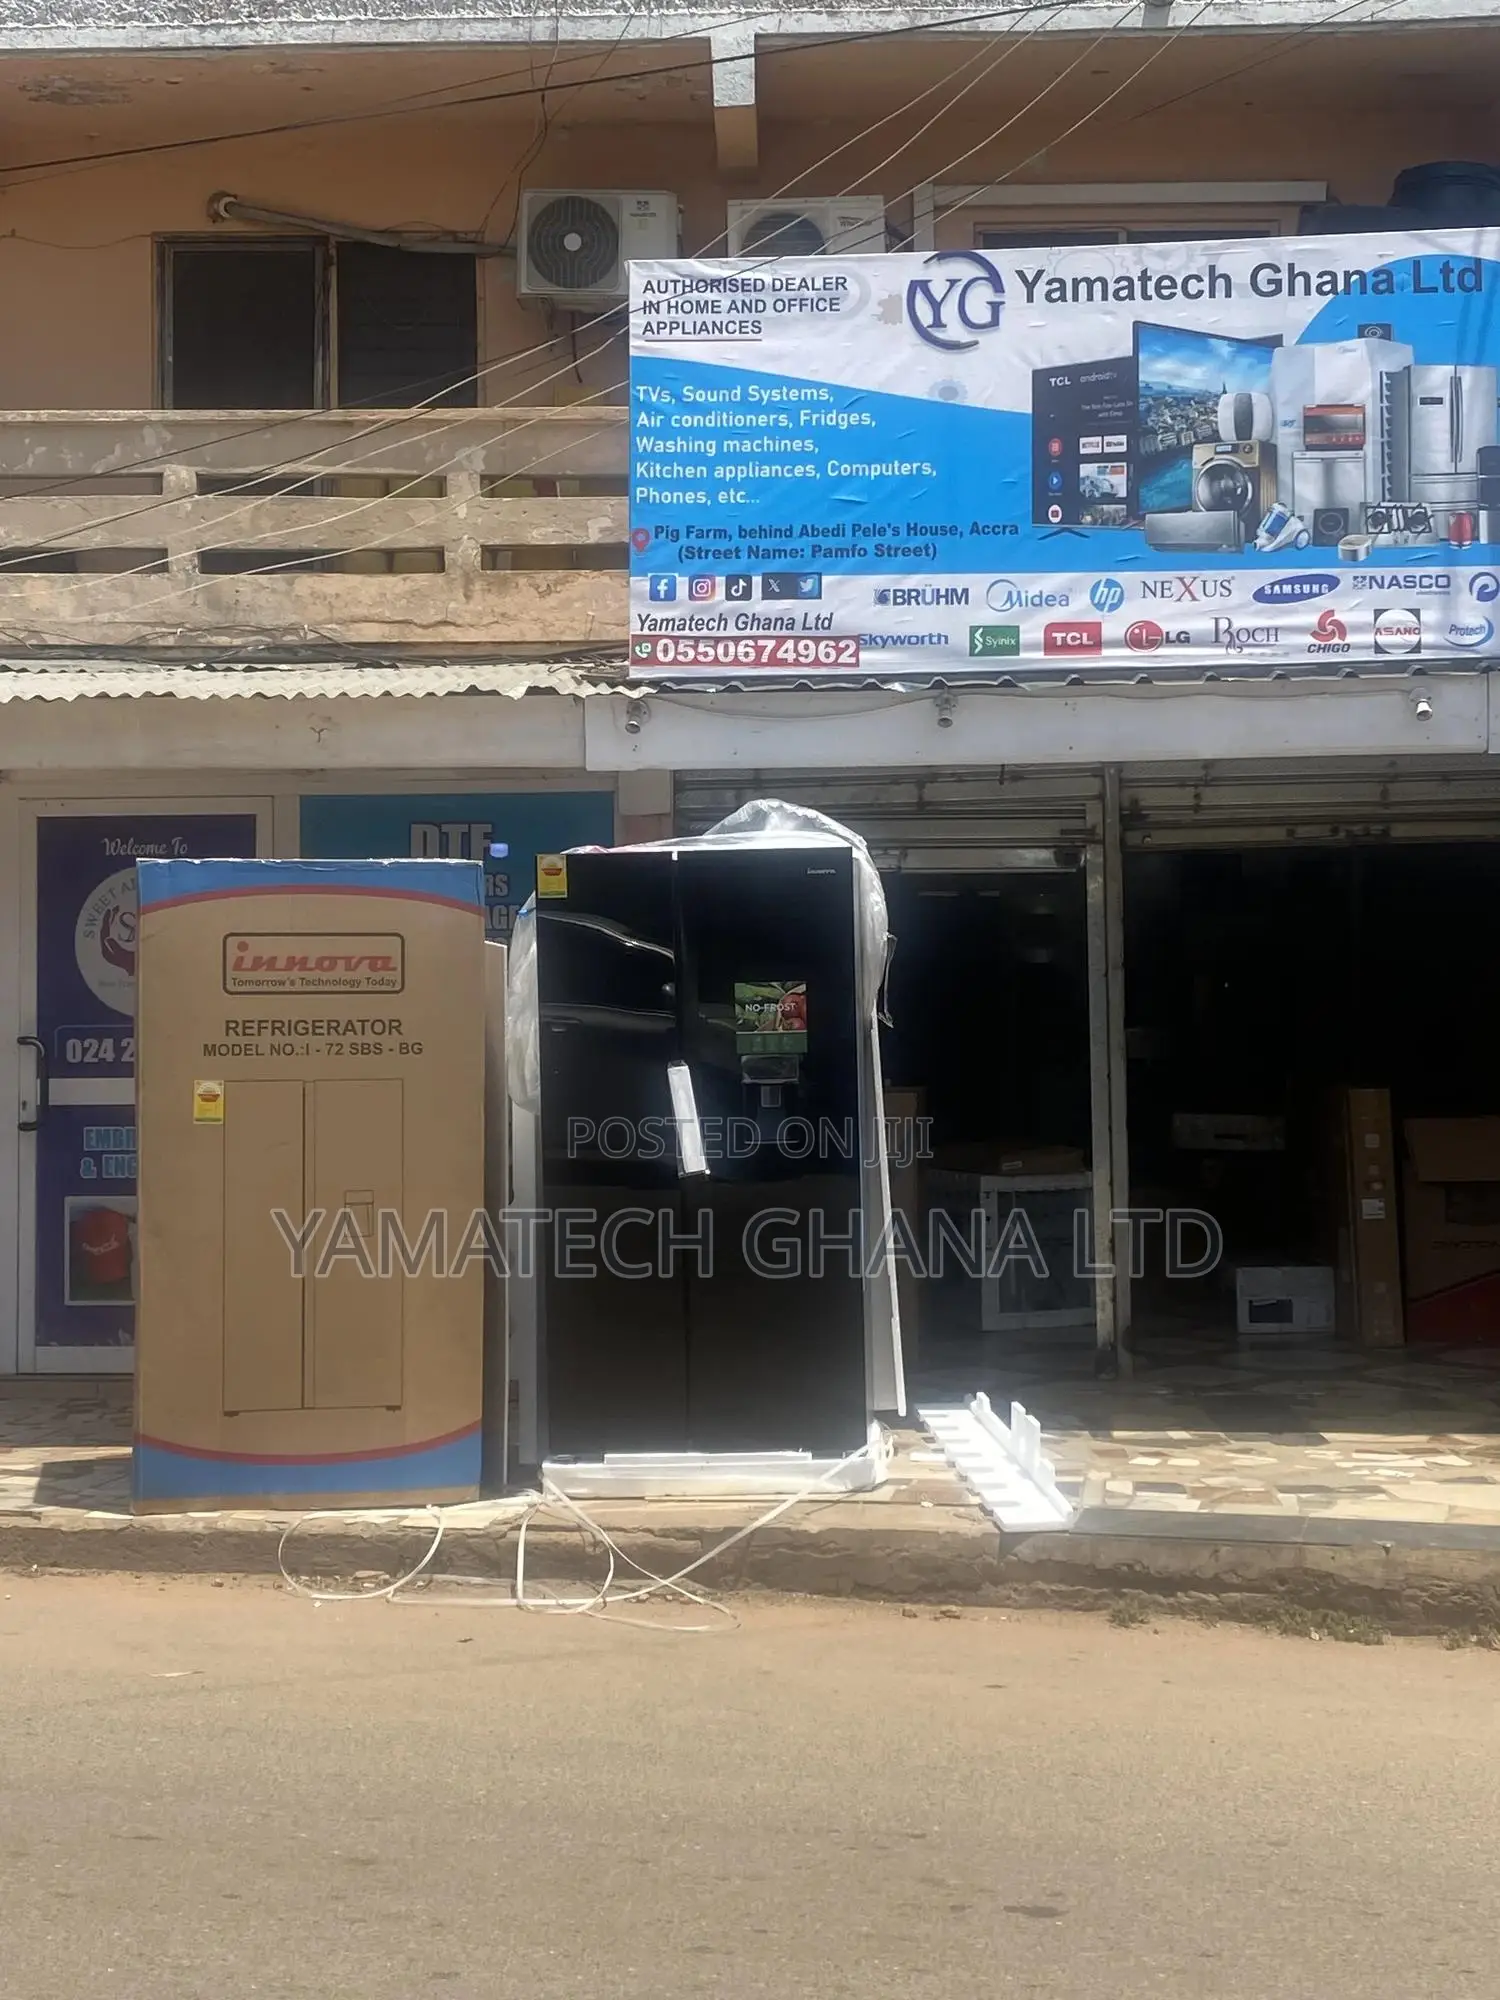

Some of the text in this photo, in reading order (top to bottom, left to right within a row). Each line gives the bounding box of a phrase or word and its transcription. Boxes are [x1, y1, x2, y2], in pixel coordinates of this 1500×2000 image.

[642, 276, 848, 295] AUTHORISED DEALER
[1015, 256, 1483, 304] Yamatech Ghana Ltd
[642, 296, 841, 315] IN HOME AND OFFICE
[642, 319, 762, 336] APPLIANCES
[1049, 376, 1072, 387] TCL
[636, 384, 834, 406] TVs, Sound Systems,
[636, 410, 877, 432] Air conditioners, Fridges,
[636, 436, 819, 456] Washing machines,
[636, 459, 937, 483] Kitchen appliances, Computers,
[636, 487, 760, 506] Phones, etc...
[654, 521, 1020, 543] Pig Farm, behind Abedi Pele's House, Accra
[677, 542, 938, 563] (Street Name: Pamfo Street)
[1140, 576, 1233, 601] NEXUS
[1263, 583, 1329, 595] SAMSUNG
[1368, 574, 1451, 591] NASCO
[893, 583, 970, 607] BRÜHM
[1001, 587, 1070, 609] Midea
[1094, 578, 1121, 613] hp
[636, 611, 834, 633] Yamatech Ghana Ltd
[1375, 625, 1421, 637] ASANO
[1448, 622, 1486, 638] Protech
[859, 632, 949, 648] Skyworth
[985, 635, 1017, 647] Syinix
[1052, 631, 1094, 646] TCL
[1165, 630, 1190, 644] LG
[655, 637, 858, 664] 0550674962
[1307, 643, 1351, 654] CHIGO
[101, 836, 188, 856] Welcome To
[83, 886, 118, 940] SWEET
[231, 941, 397, 973] innova
[231, 976, 397, 989] Tomorrow's Technology Today
[745, 1002, 797, 1013] NO-FROST
[224, 1019, 404, 1037] REFRIGERATOR
[65, 1038, 116, 1063] 024
[203, 1043, 265, 1057] MODEL
[325, 1042, 345, 1056] 72
[349, 1042, 384, 1056] SBS
[398, 1041, 424, 1056] BG
[80, 1157, 97, 1179] &
